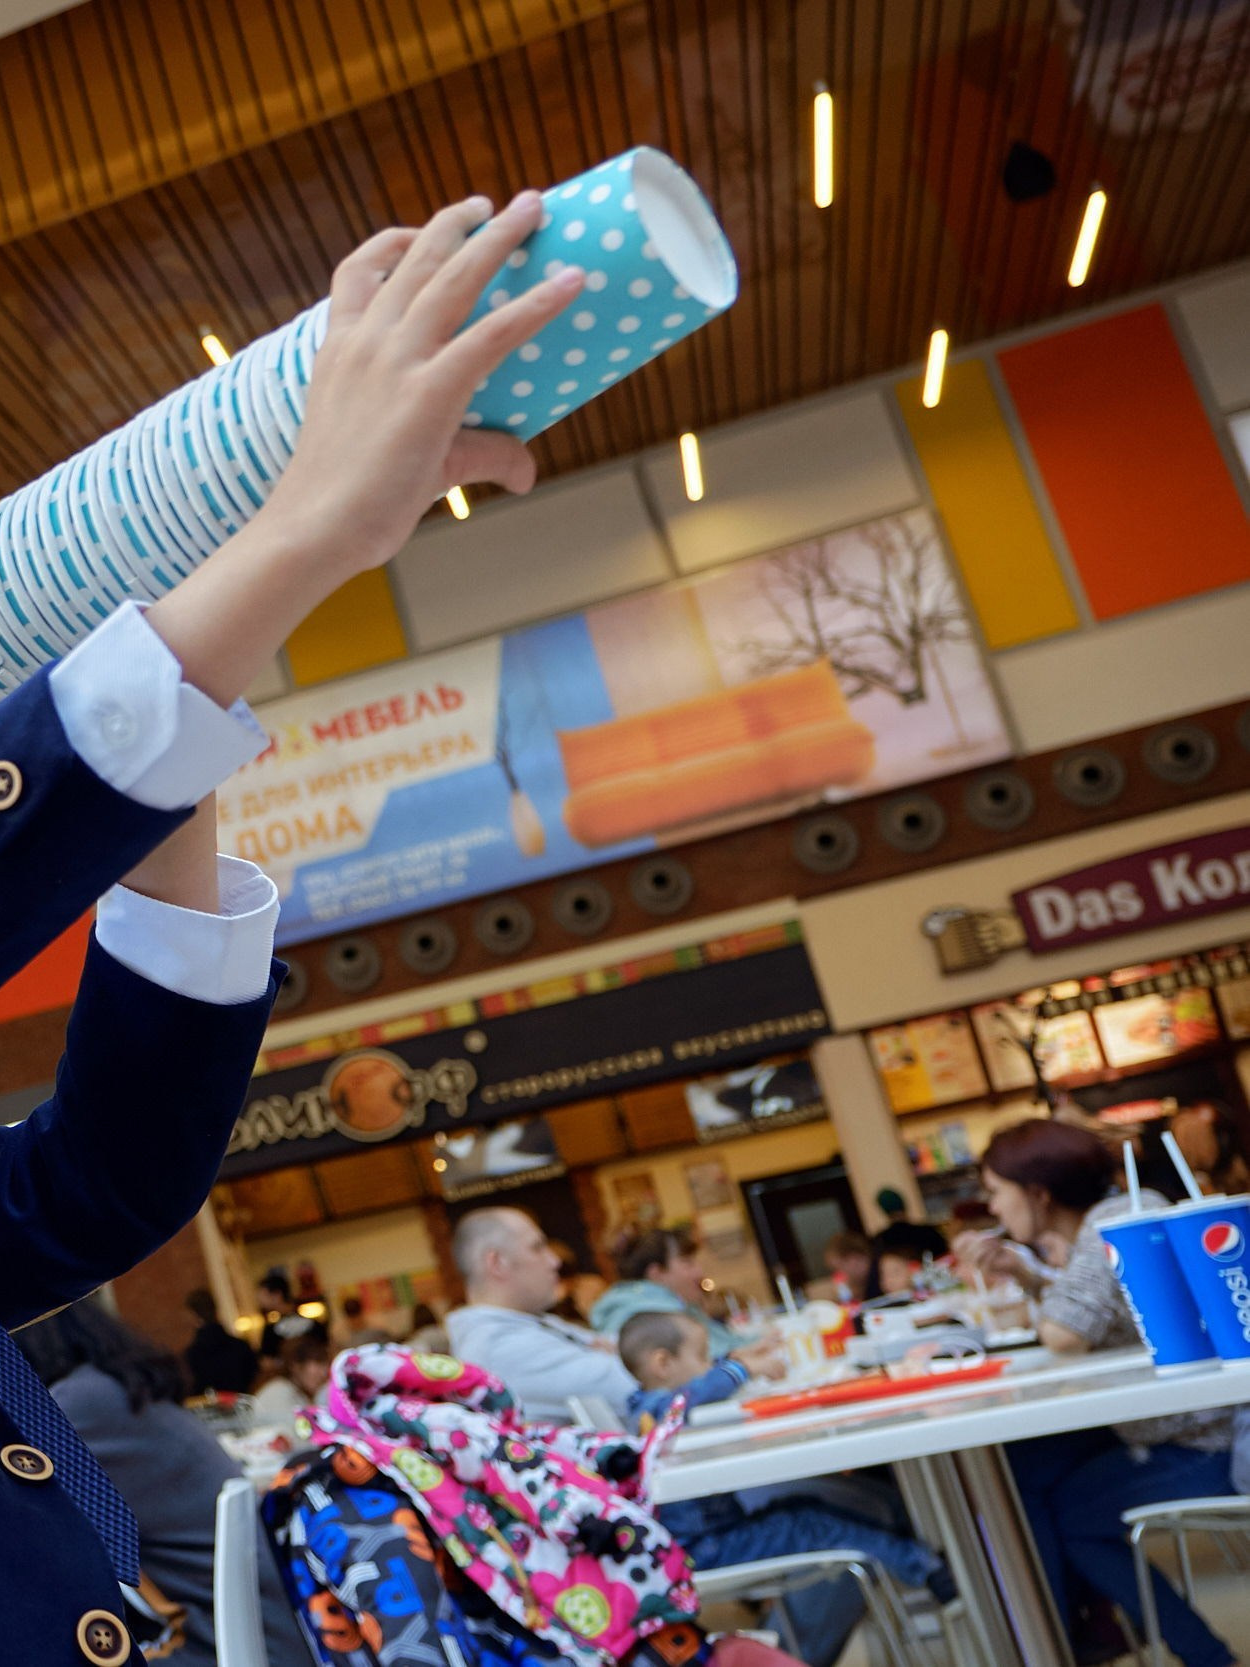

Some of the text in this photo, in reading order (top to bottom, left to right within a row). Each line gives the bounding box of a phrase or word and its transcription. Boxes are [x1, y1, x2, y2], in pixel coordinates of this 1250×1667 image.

[309, 683, 465, 745] МЕБЕЛЬ
[240, 780, 300, 820] ДЛЯ
[305, 731, 478, 797] ИНТЕРЬЕРА
[234, 803, 365, 866] ДОМА
[1028, 880, 1145, 940] Das
